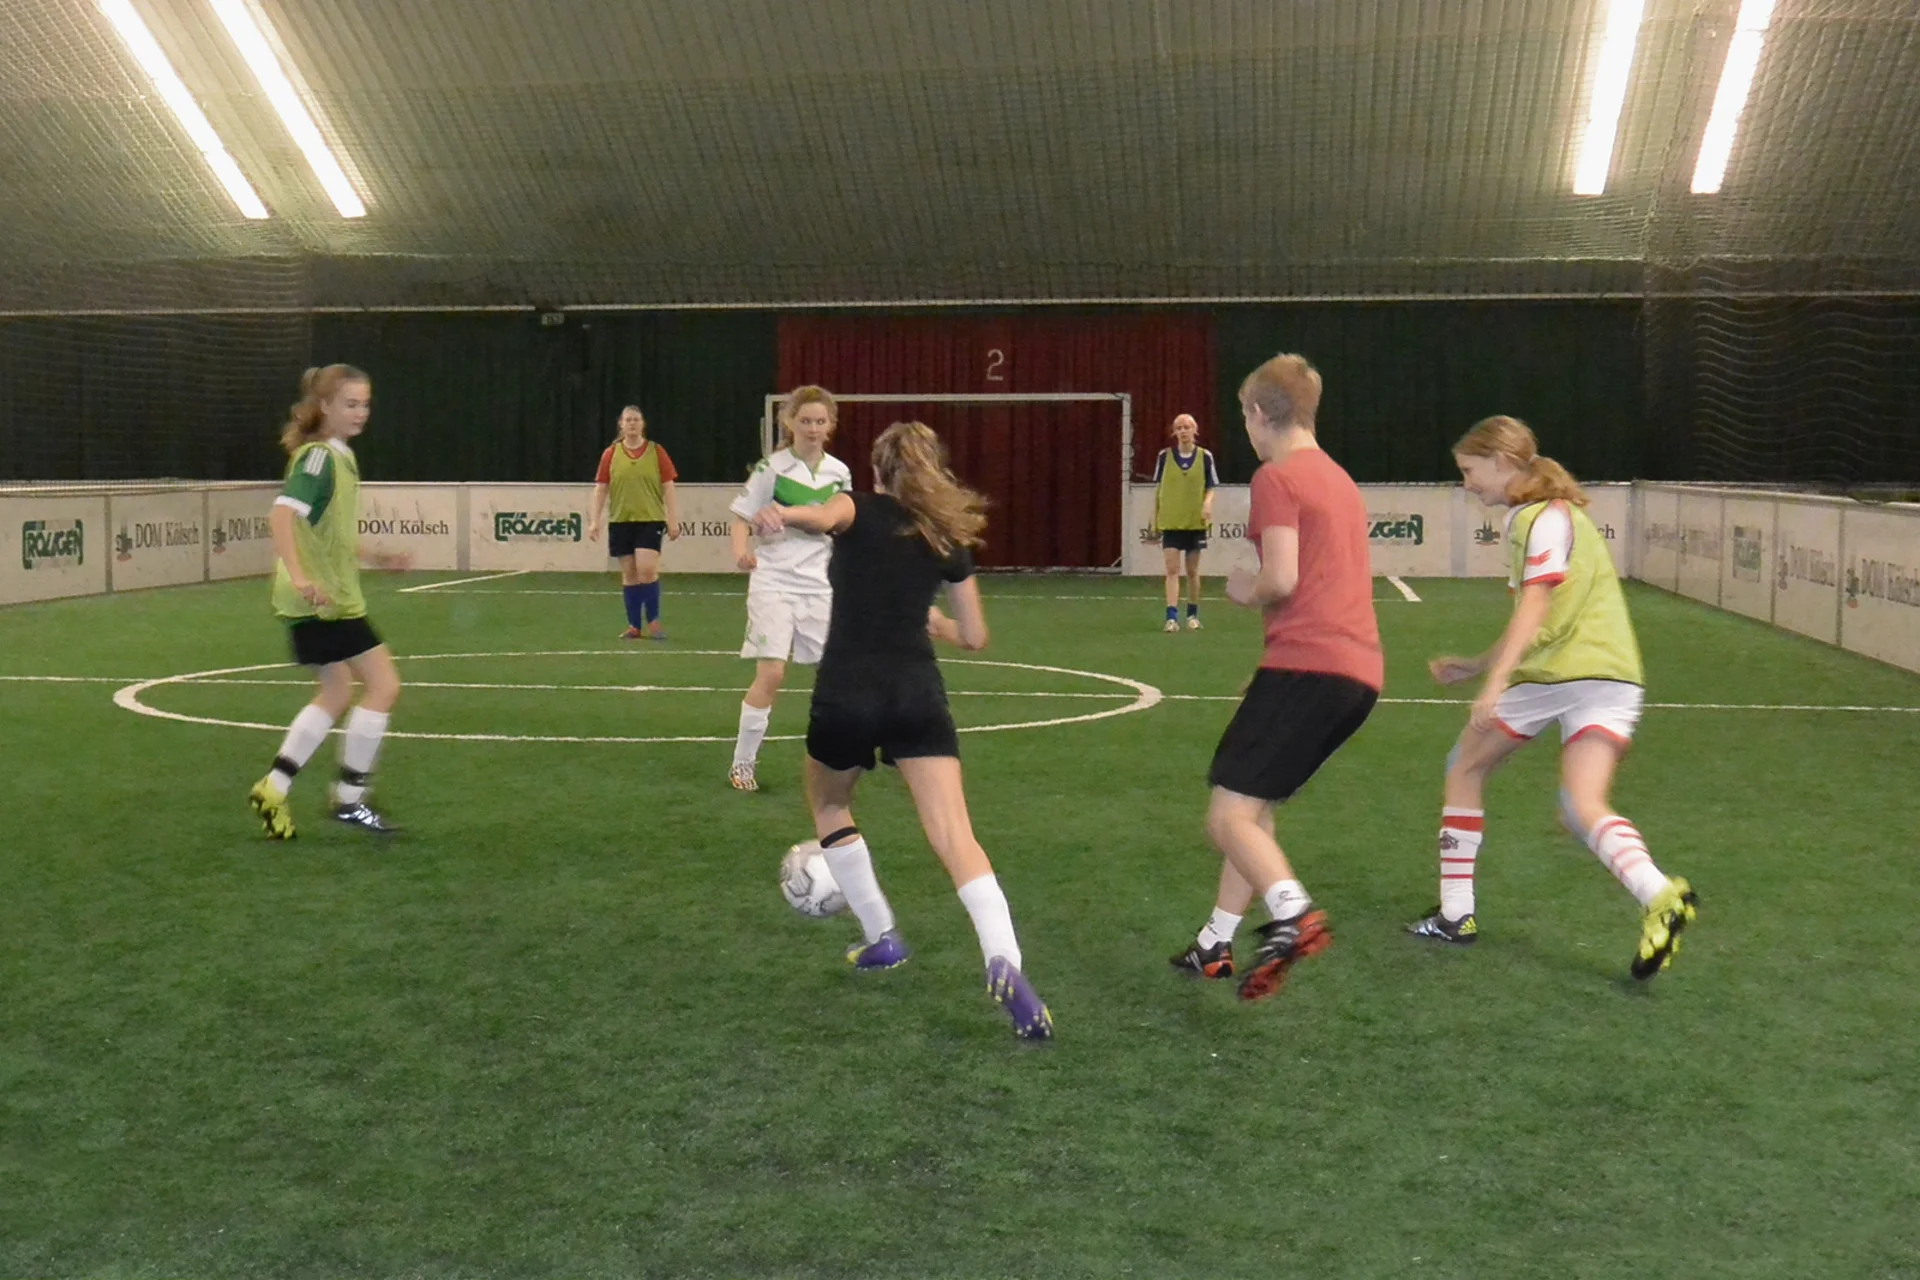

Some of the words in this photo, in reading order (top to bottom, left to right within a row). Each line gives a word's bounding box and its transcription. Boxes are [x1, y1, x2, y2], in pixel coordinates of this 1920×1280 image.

[987, 349, 1004, 381] 2
[135, 523, 162, 548] DOM
[165, 521, 199, 546] Kölsch
[228, 518, 252, 541] DOM
[358, 520, 394, 535] DOM
[400, 520, 449, 535] Kölsch
[1219, 523, 1248, 538] Köl
